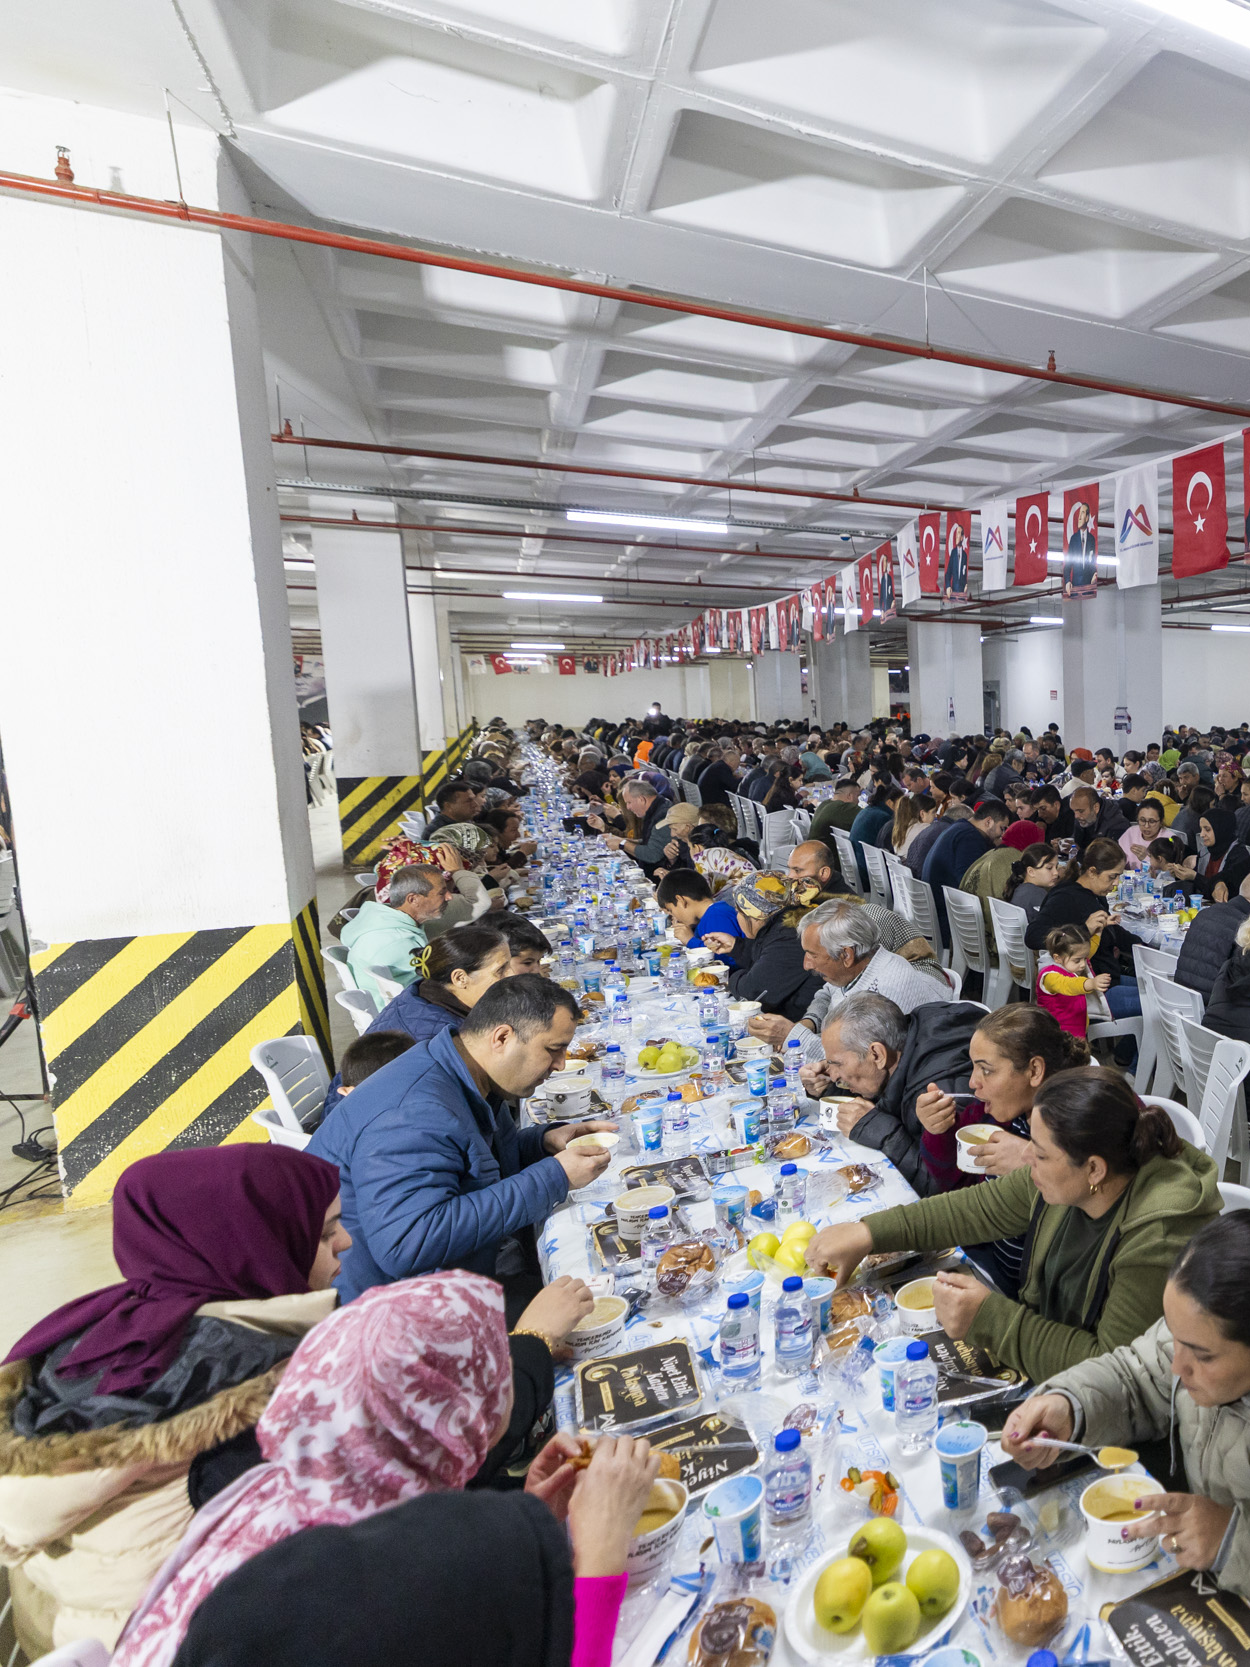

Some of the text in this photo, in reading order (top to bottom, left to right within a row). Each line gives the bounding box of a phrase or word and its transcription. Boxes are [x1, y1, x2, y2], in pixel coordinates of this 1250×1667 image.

[645, 1372, 669, 1402] Kalpten
[660, 1356, 693, 1399] Niyet Ettik,
[1123, 1624, 1165, 1667] Ettik,
